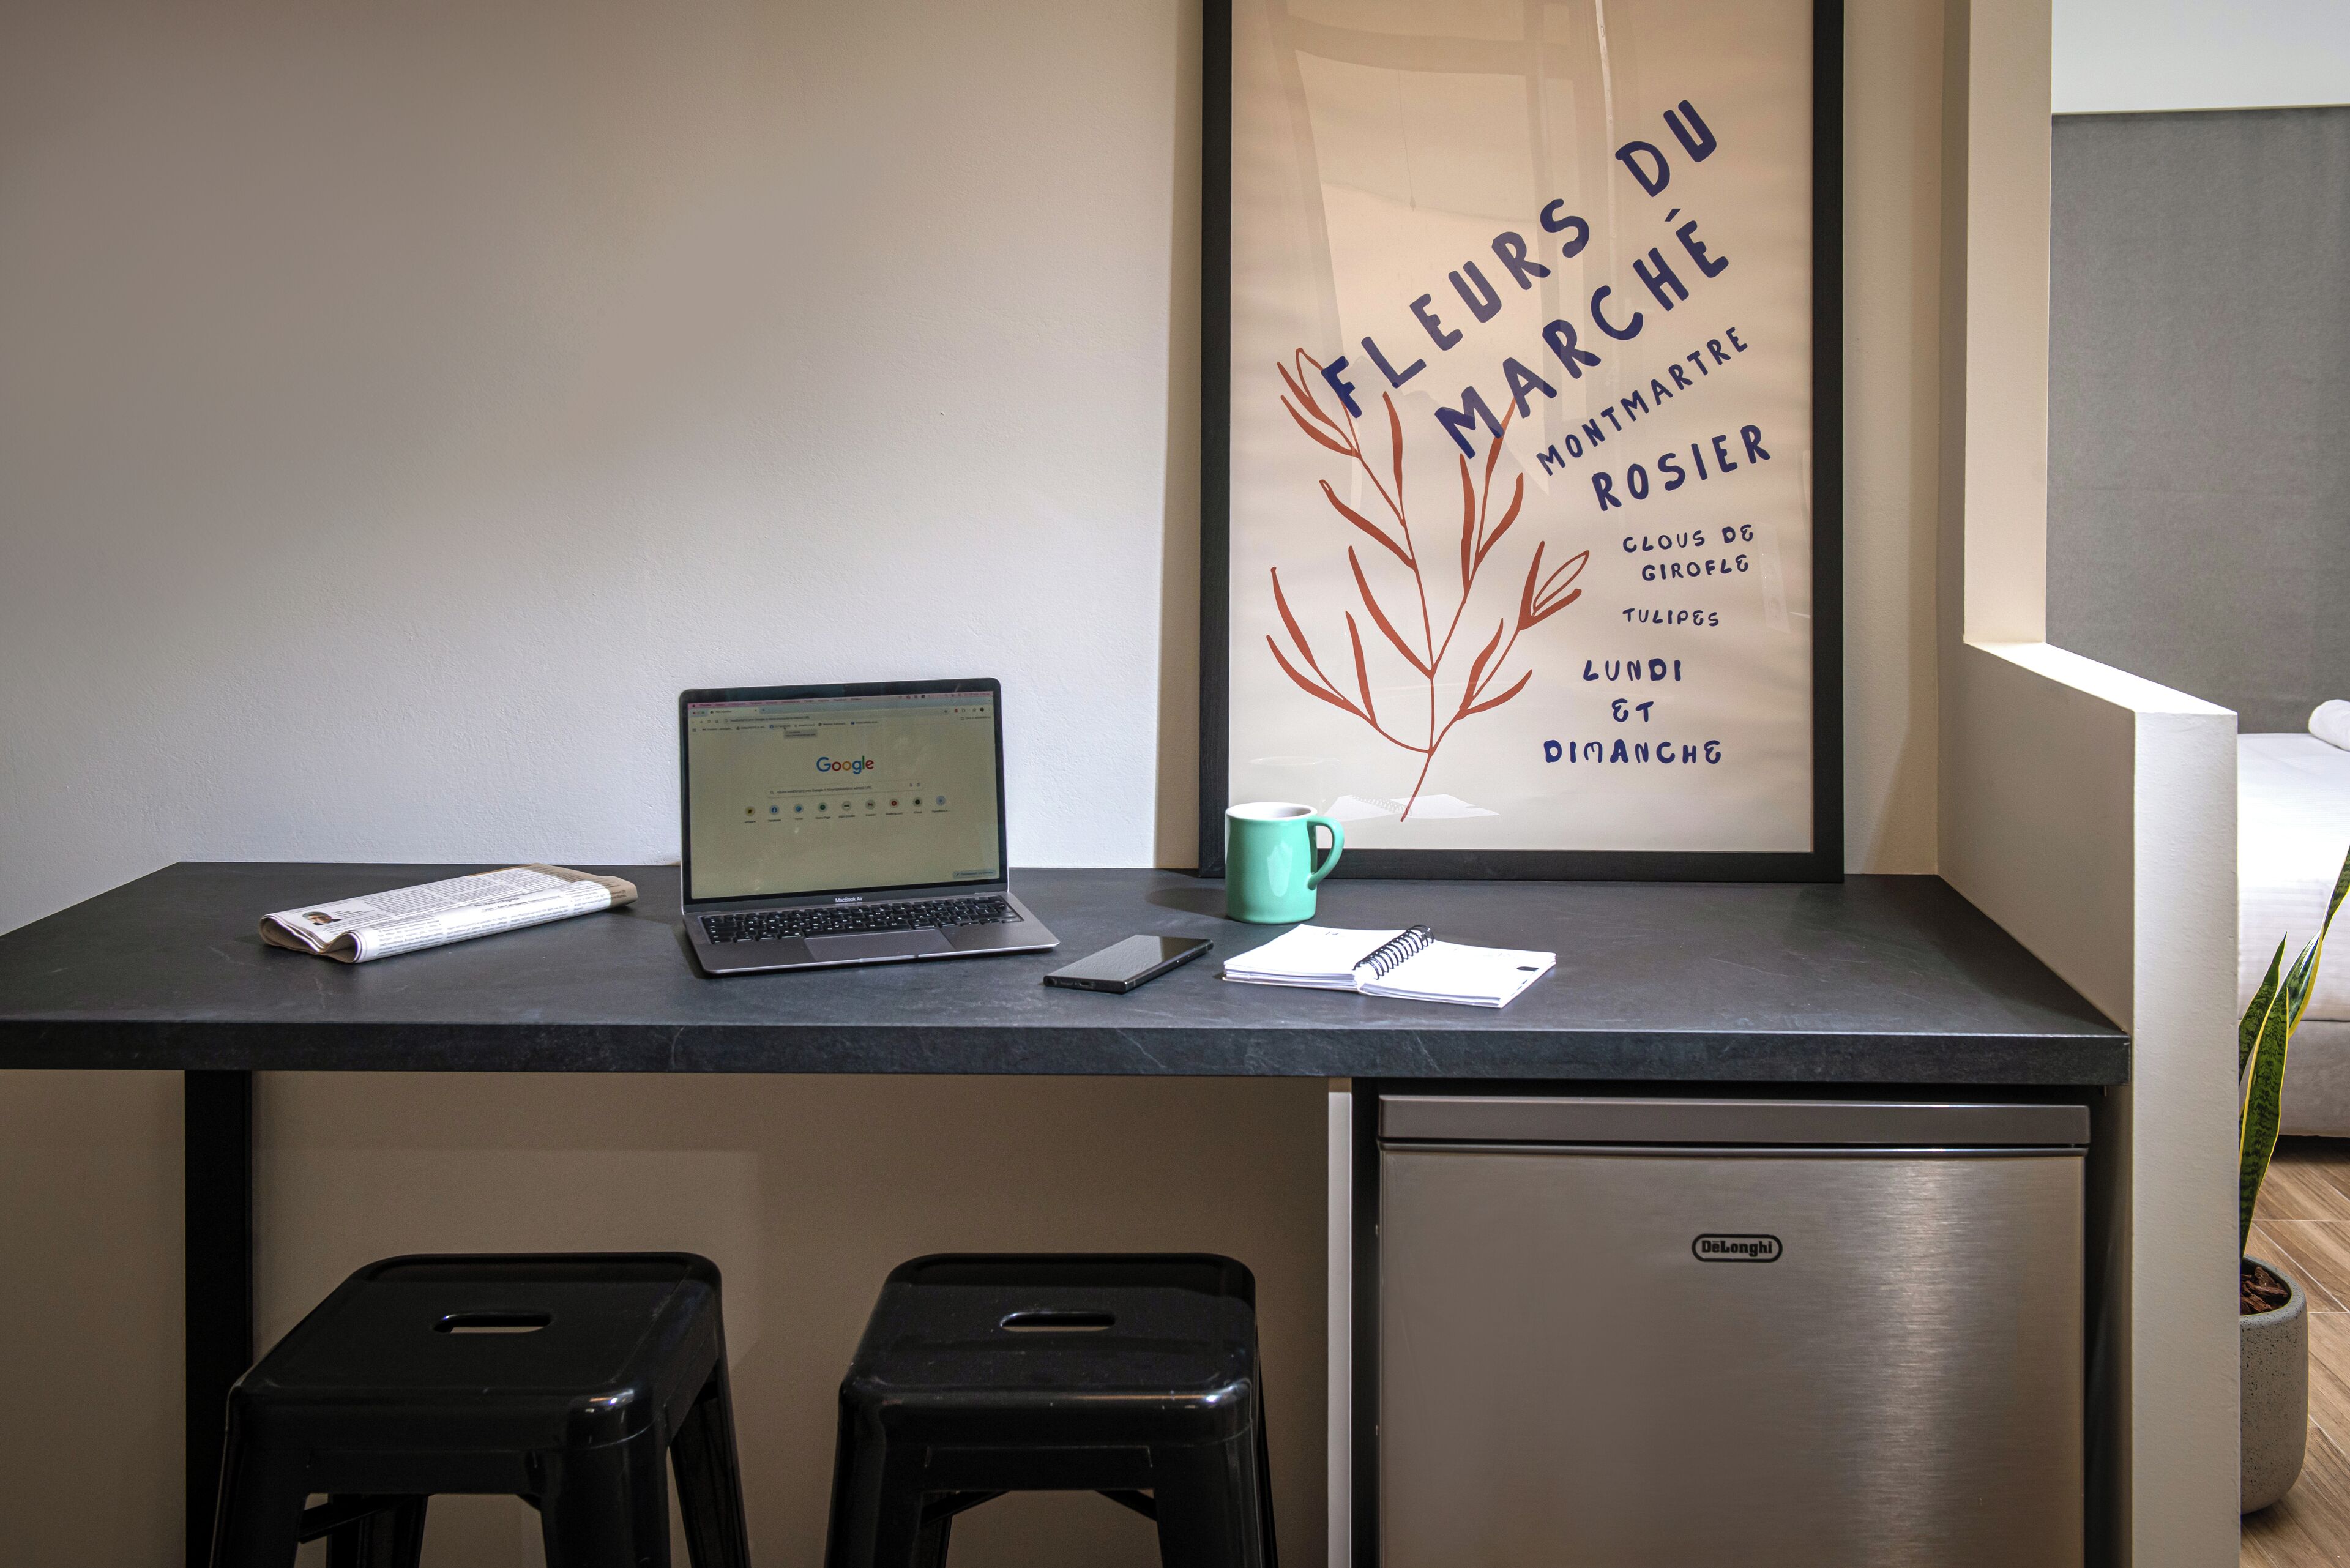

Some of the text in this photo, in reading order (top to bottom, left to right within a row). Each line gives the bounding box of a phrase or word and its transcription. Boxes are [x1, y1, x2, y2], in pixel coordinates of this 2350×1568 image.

[1321, 99, 1717, 419] FLEURS DU
[1434, 208, 1730, 460] MARCHÉ
[1535, 326, 1748, 476] MONTMARTRE
[1591, 424, 1771, 512] ROSIER
[1622, 523, 1755, 553] CLOUS DE
[1641, 554, 1750, 581] GIROFLE
[1622, 608, 1720, 627] TULIPES
[1582, 657, 1683, 682] LUNDI
[1611, 698, 1655, 723] ET
[816, 755, 875, 775] Google
[1543, 739, 1723, 764] DIMANCHE
